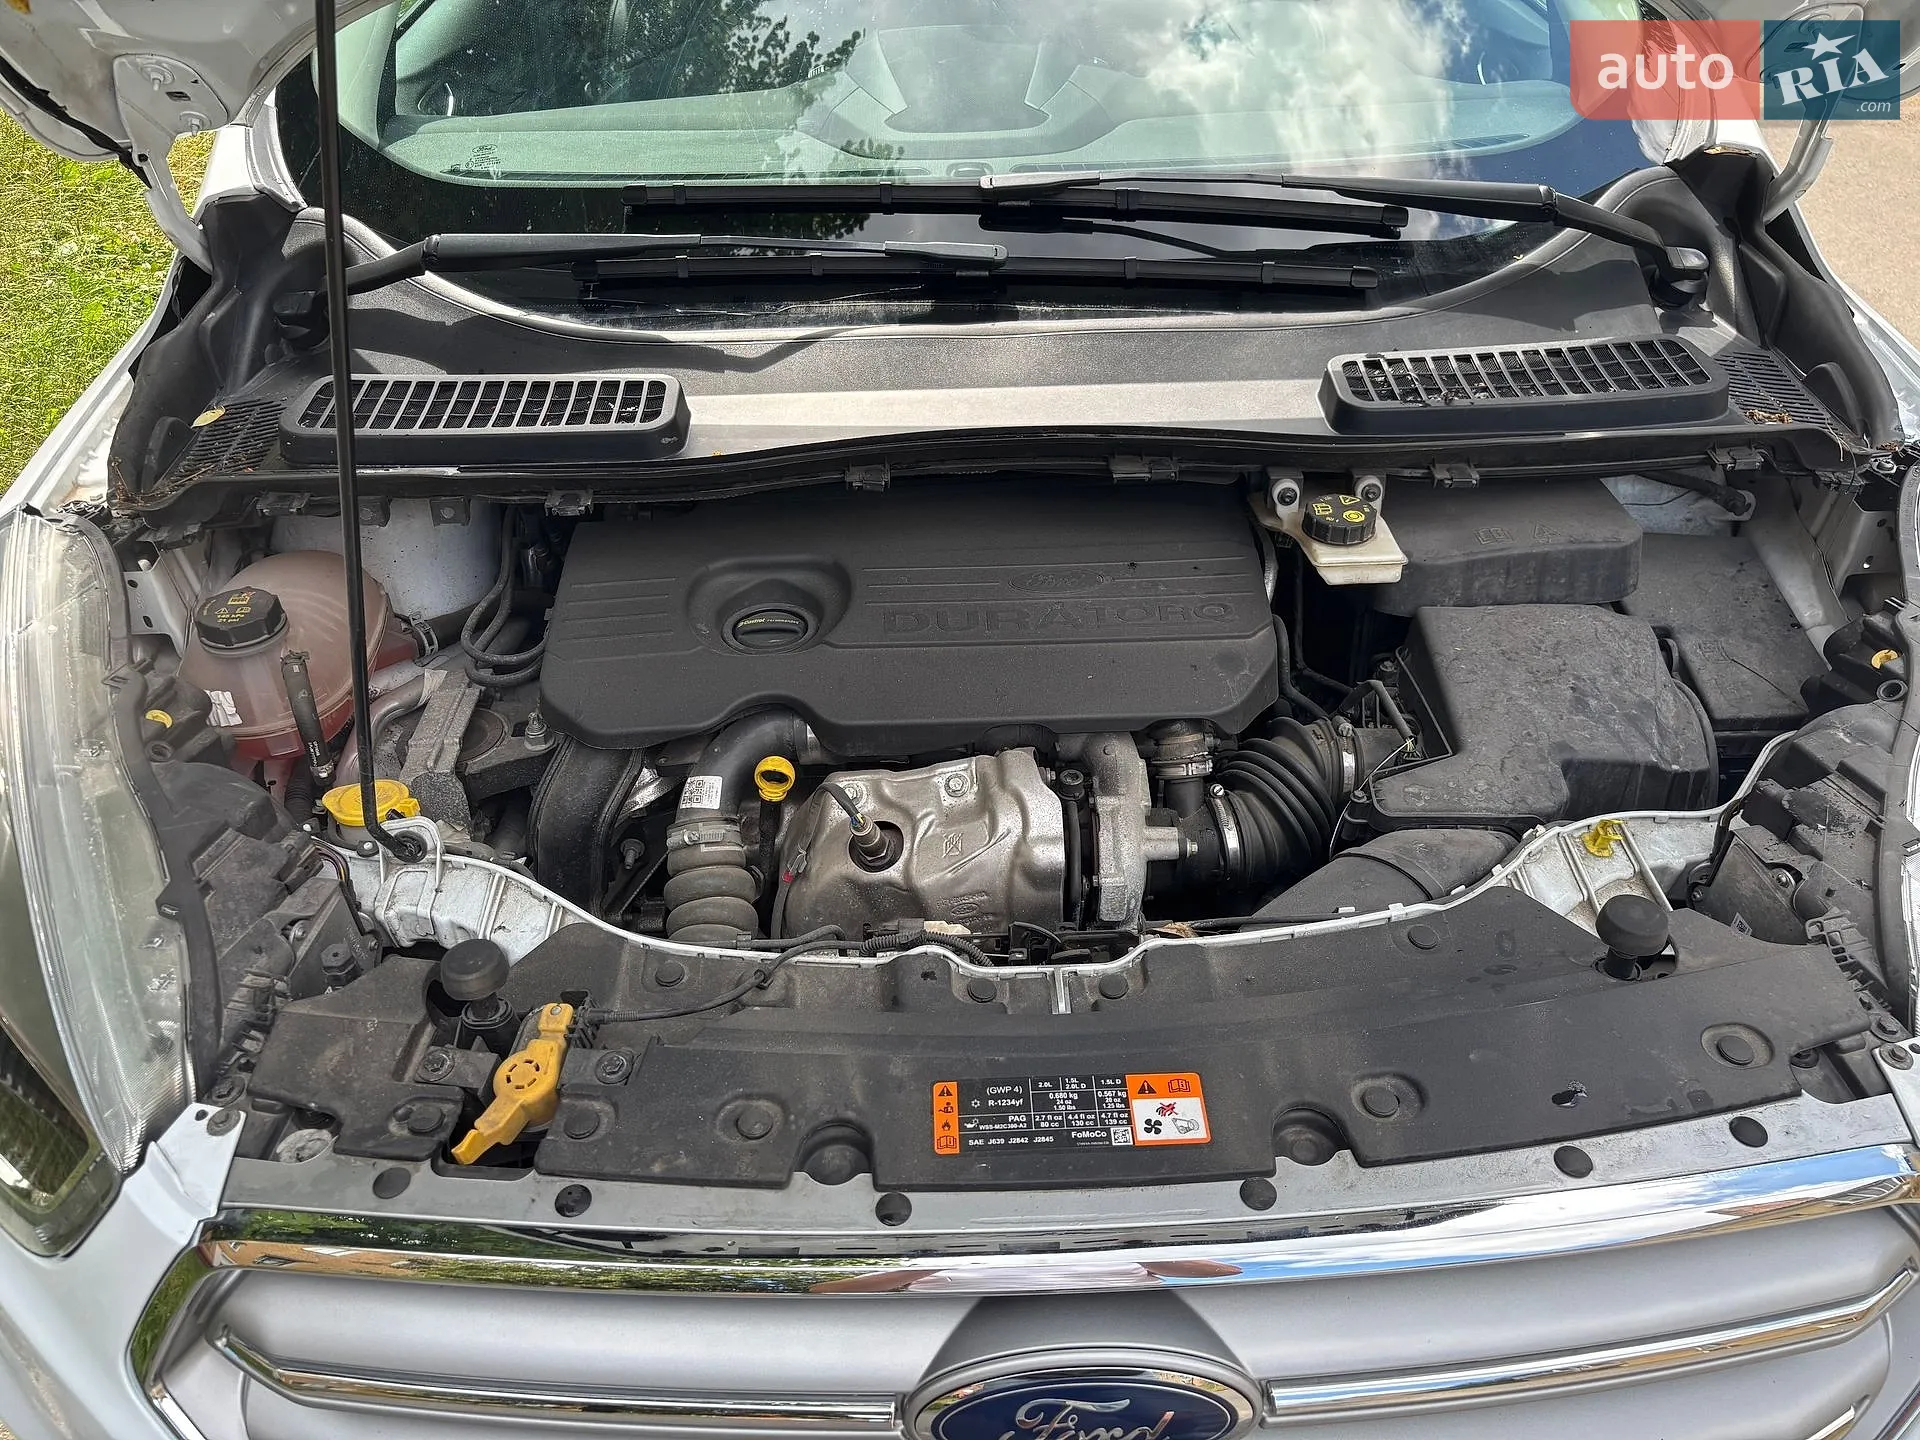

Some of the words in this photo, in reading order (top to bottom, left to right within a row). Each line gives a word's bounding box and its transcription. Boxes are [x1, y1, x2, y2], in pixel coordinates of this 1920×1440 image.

[986, 1086, 1012, 1096] (GWP
[1013, 1086, 1022, 1094] 4)
[1117, 1090, 1127, 1098] kg
[1069, 1092, 1078, 1100] kg
[988, 1098, 1024, 1107] R-1234yf
[1071, 1130, 1107, 1138] FoMoCo
